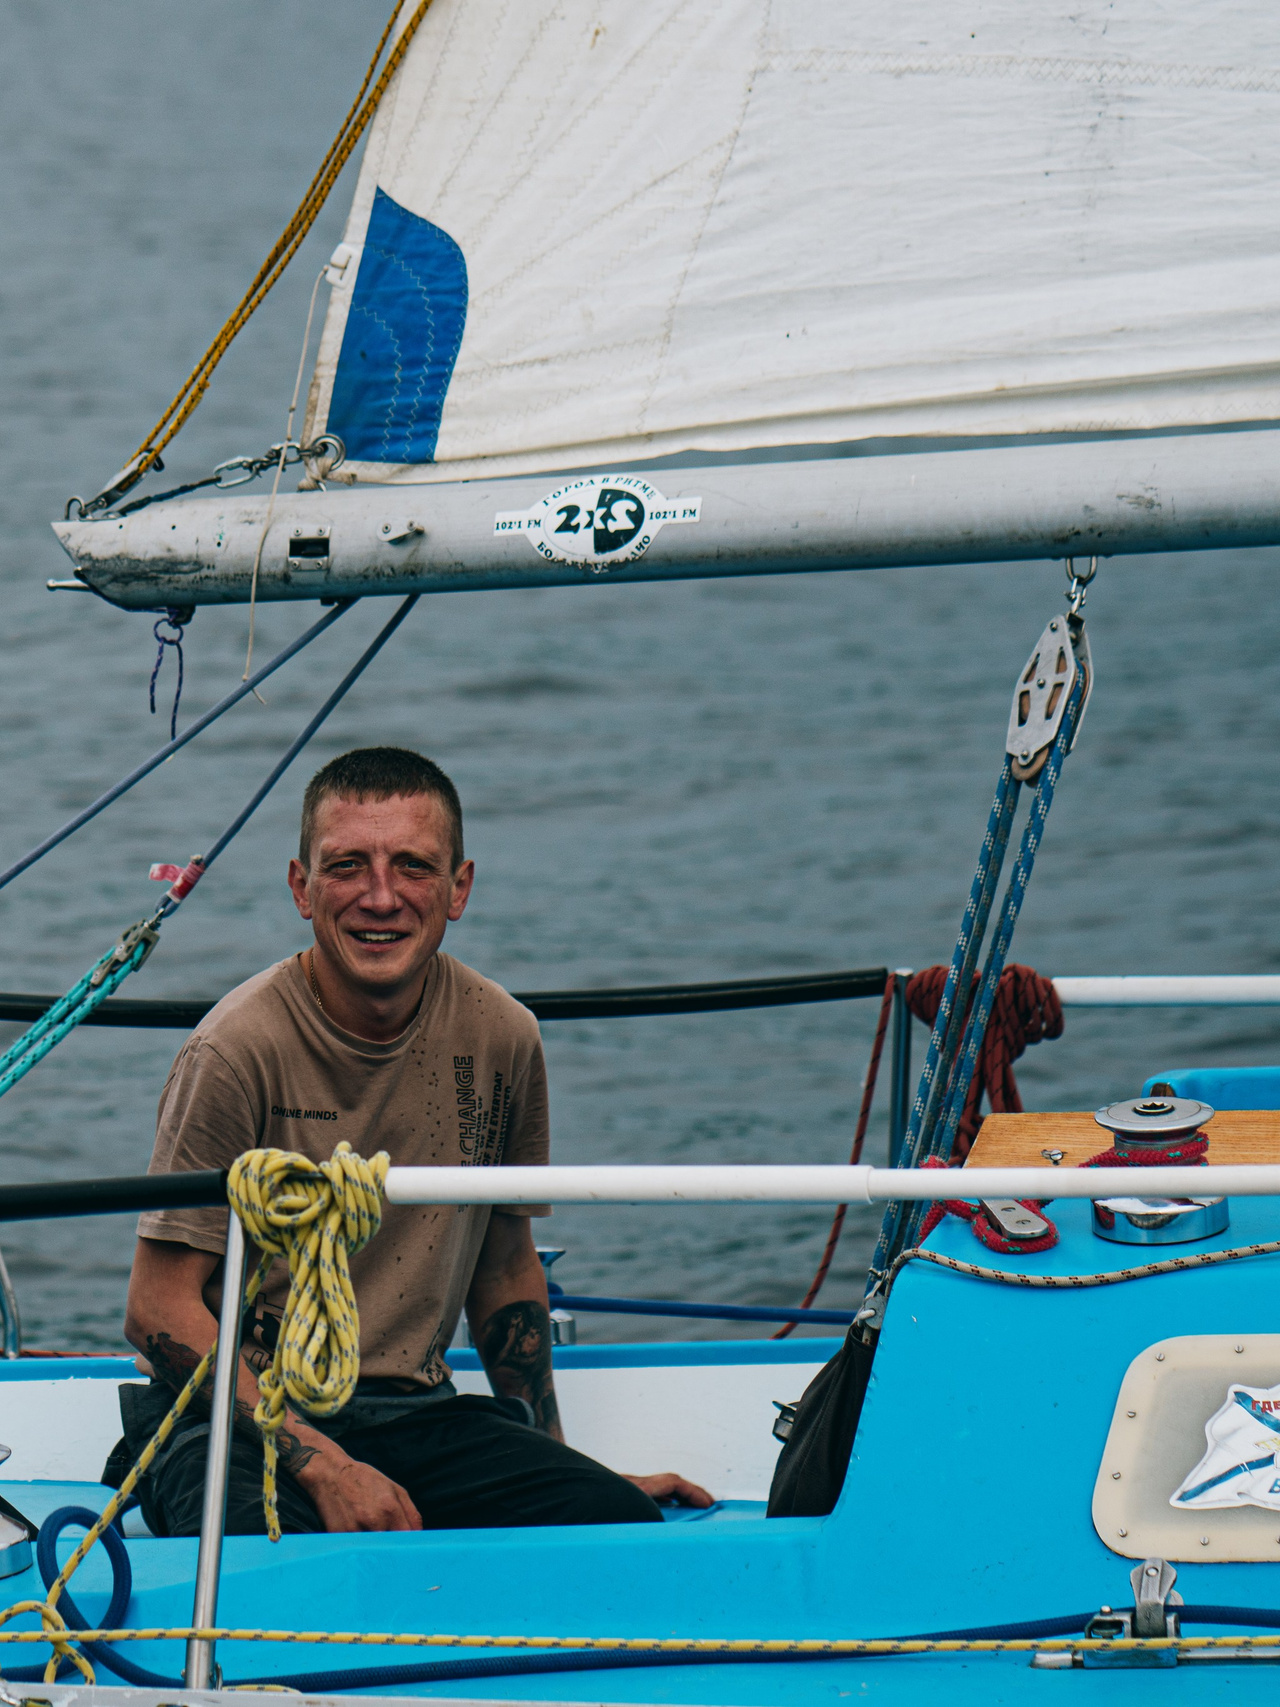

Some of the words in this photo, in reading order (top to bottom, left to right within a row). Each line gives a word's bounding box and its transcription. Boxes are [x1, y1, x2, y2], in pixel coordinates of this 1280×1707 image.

[682, 509, 697, 518] FM
[527, 519, 542, 529] FM
[453, 1055, 477, 1155] CHANGE
[490, 1071, 503, 1126] EVERYDAY
[304, 1109, 338, 1121] MINDS
[486, 1128, 497, 1149] THE
